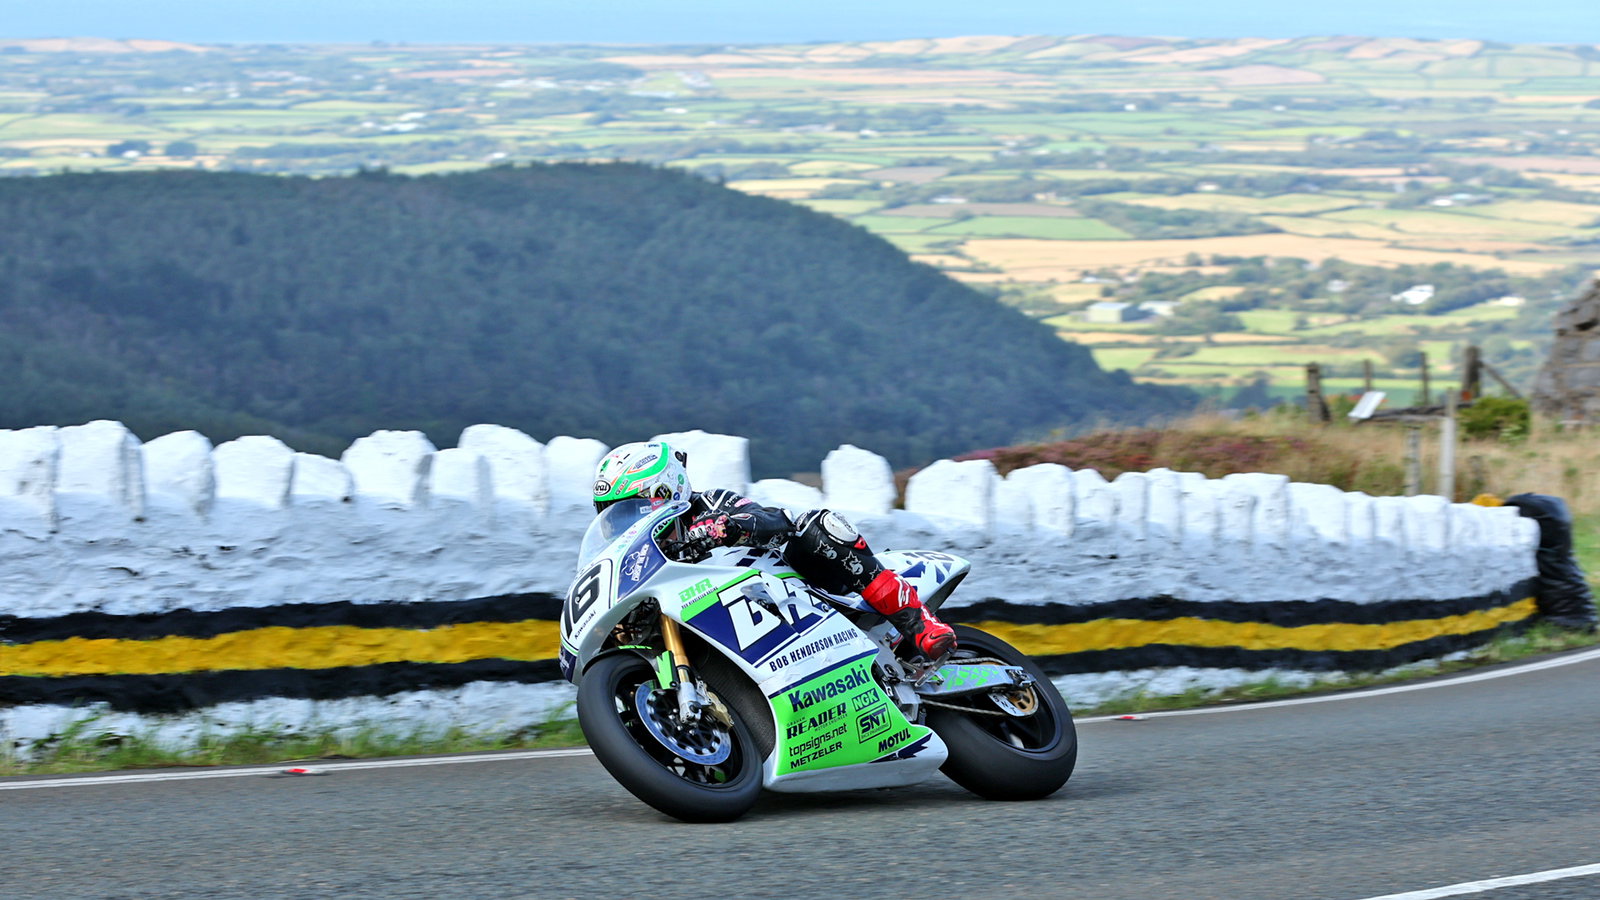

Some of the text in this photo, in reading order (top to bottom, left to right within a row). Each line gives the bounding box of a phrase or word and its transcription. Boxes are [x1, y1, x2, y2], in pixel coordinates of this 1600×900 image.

[575, 610, 597, 640] Kawasaki
[769, 628, 858, 672] BOB HENDERSON RACING
[788, 664, 871, 712] Kawasaki
[852, 689, 879, 710] NGK
[786, 702, 846, 740] READER
[860, 708, 886, 734] SNT
[789, 723, 848, 757] topsigns.net
[790, 741, 843, 769] METZELER
[878, 727, 911, 753] MOTUL
